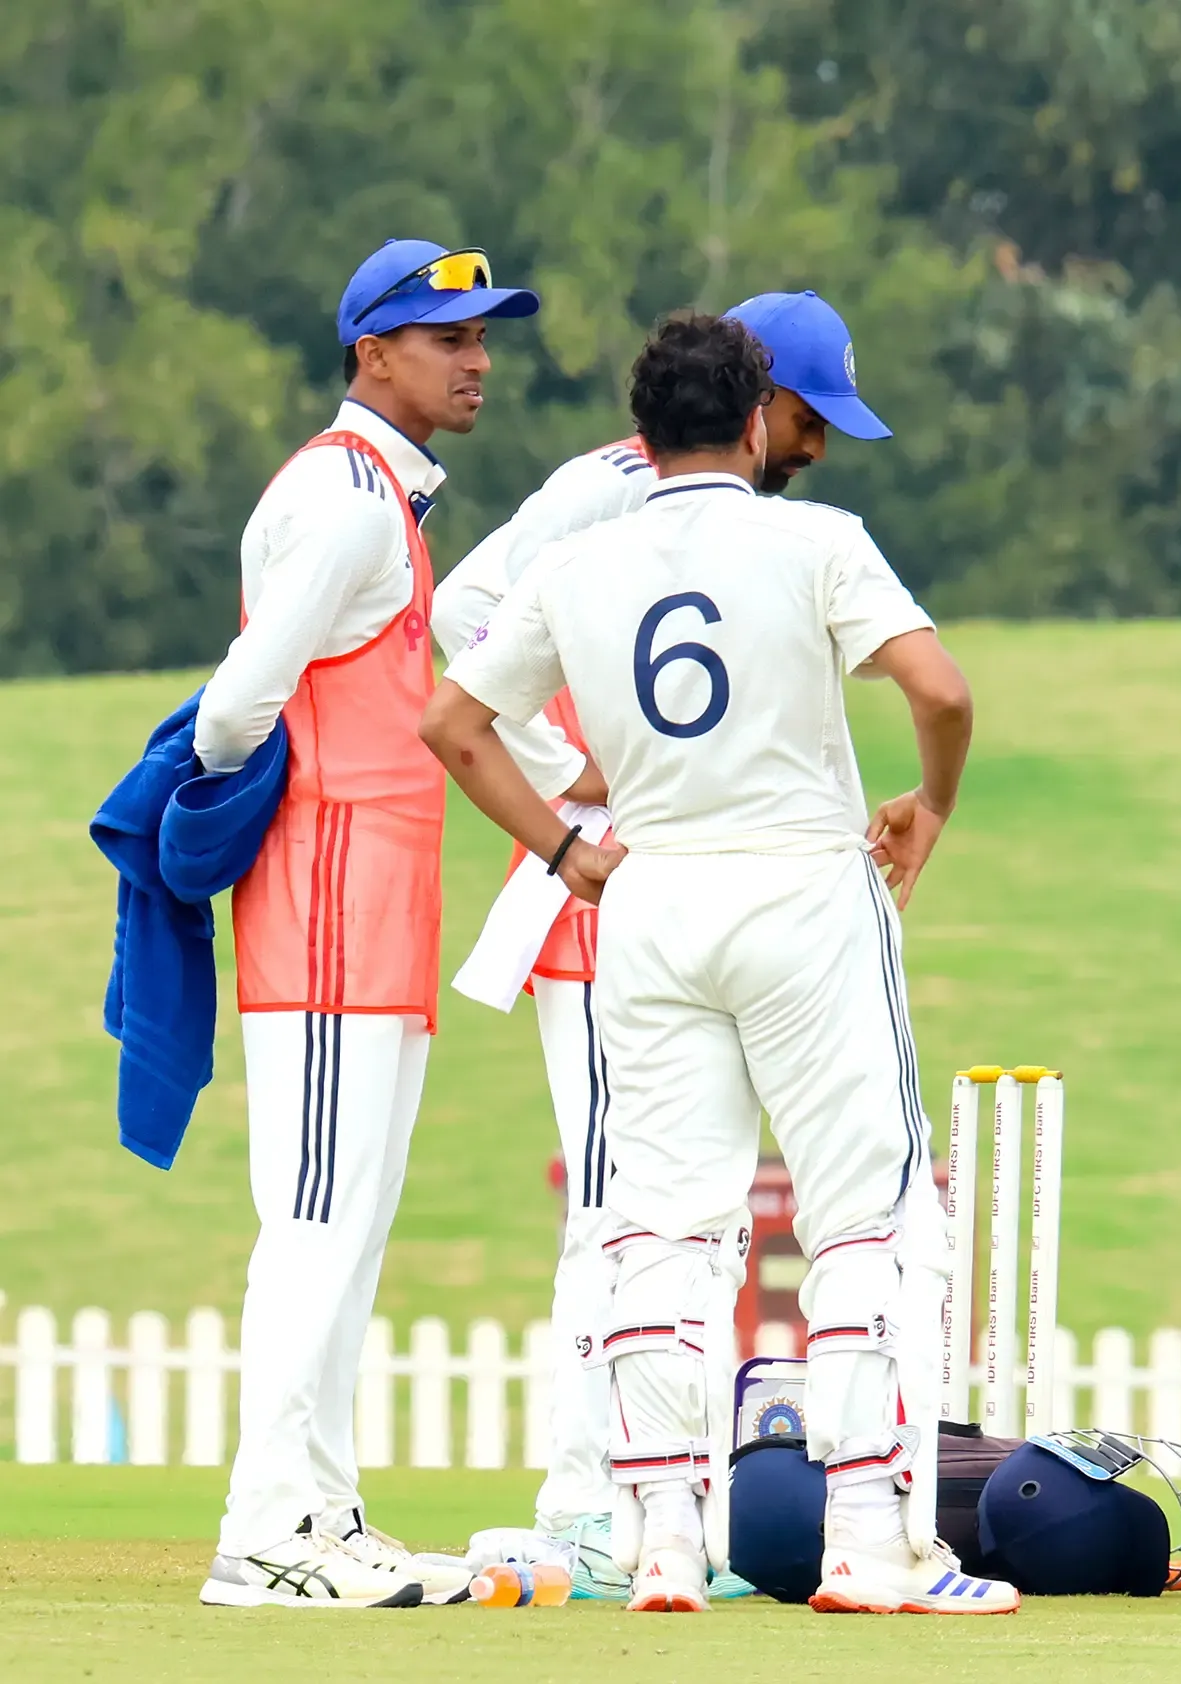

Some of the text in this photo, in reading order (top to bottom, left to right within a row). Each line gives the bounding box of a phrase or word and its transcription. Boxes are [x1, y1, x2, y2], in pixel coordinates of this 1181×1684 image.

[634, 591, 730, 738] 6
[948, 1103, 960, 1217] IDFC FIRST Bank
[991, 1102, 1003, 1217] IDFC FIRST Bank
[1033, 1102, 1044, 1217] IDFC FIRST Bank
[942, 1352, 951, 1384] IDFC
[944, 1309, 952, 1348] FIRST
[988, 1268, 998, 1384] IDFC FIRST Bank
[1027, 1269, 1039, 1384] IDFC FIRST Bank
